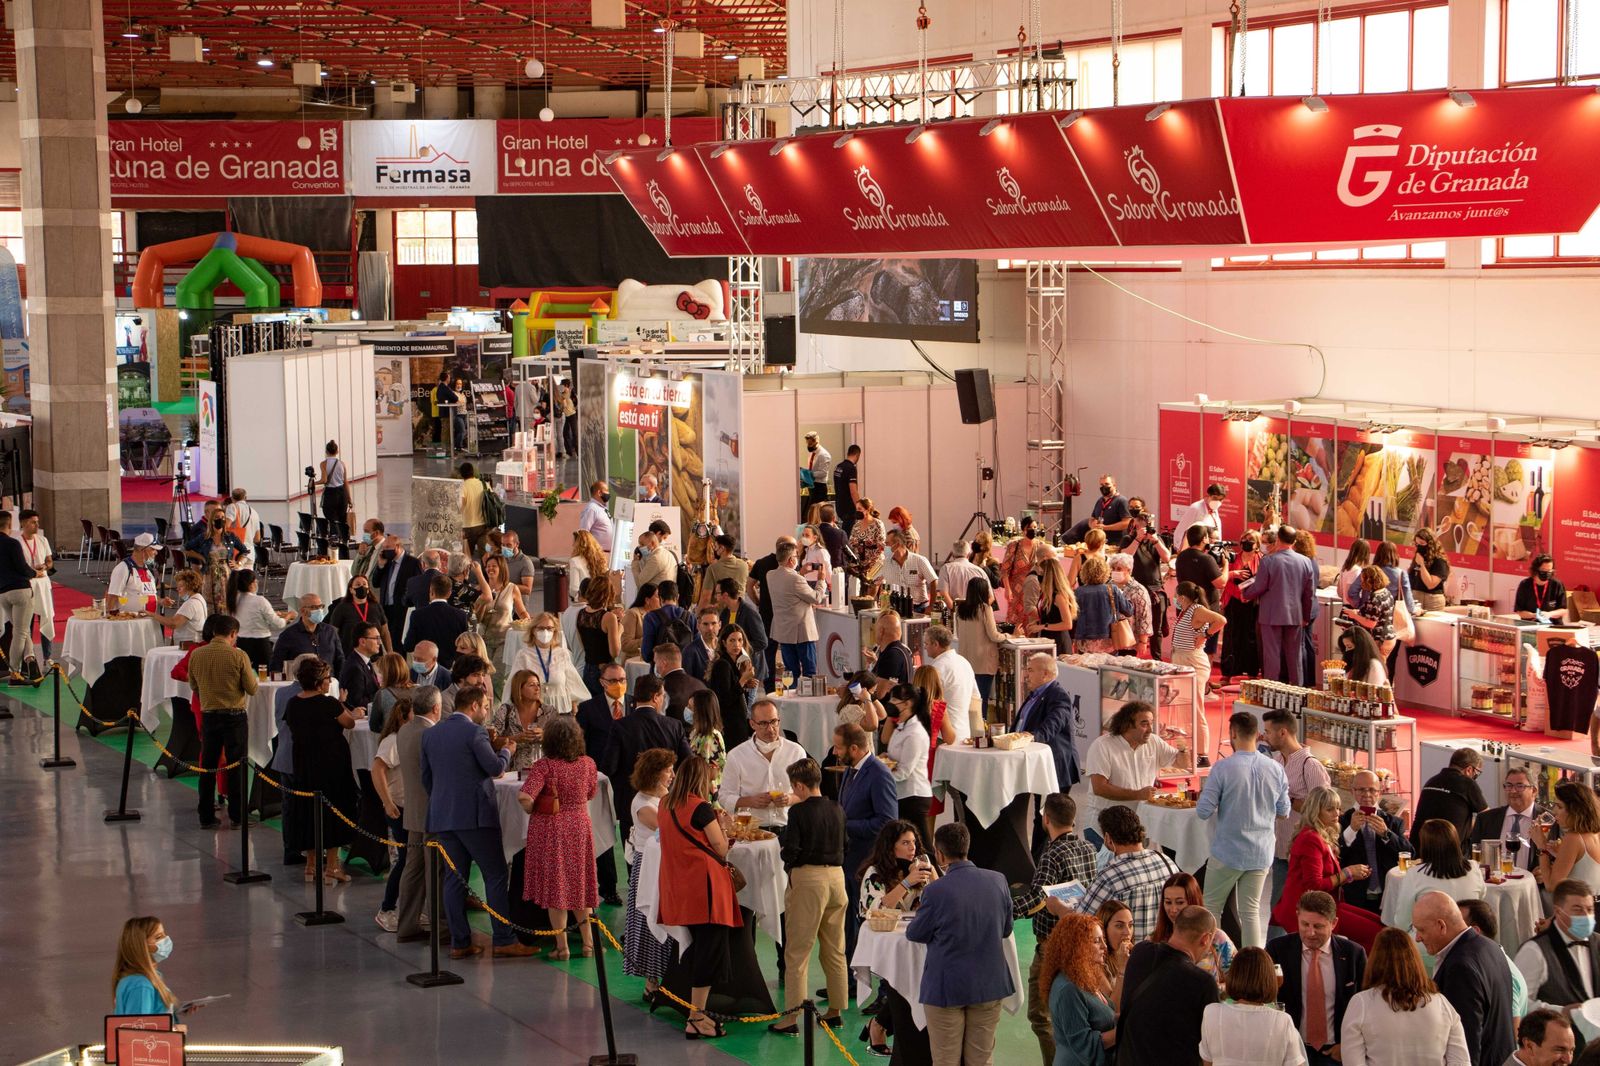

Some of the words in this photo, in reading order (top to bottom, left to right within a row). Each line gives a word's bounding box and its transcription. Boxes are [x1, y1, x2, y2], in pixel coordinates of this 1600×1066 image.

[109, 139, 135, 151] ran
[140, 137, 182, 152] Hotel
[502, 135, 541, 150] Gran
[546, 135, 589, 150] Hotel
[504, 152, 571, 177] Luna
[1405, 141, 1538, 171] Diputación
[175, 154, 210, 179] de
[219, 154, 339, 180] Granada
[376, 165, 471, 184] Fermasa
[292, 181, 340, 189] Convention
[1397, 172, 1426, 195] de
[1429, 167, 1529, 194] Granada
[986, 198, 1021, 216] Sabor
[1021, 195, 1071, 216] Granada
[1107, 193, 1157, 221] Sabor
[1387, 208, 1462, 222] Avanzamos
[1463, 206, 1509, 221] junt@s
[739, 210, 763, 226] Sabor
[762, 208, 801, 226] Granada
[843, 207, 885, 231] Sabor
[886, 204, 949, 231] Granada
[673, 214, 724, 238] Granada
[411, 344, 449, 352] BENAMAUREL
[620, 382, 638, 398] stá
[619, 408, 637, 426] está
[639, 412, 650, 426] en
[651, 410, 659, 428] ti
[424, 512, 450, 521] JAMONES
[1589, 511, 1600, 519] Sabo
[1581, 521, 1600, 529] Granad
[1409, 654, 1438, 670] GRANADA
[1560, 664, 1585, 675] GRANADA
